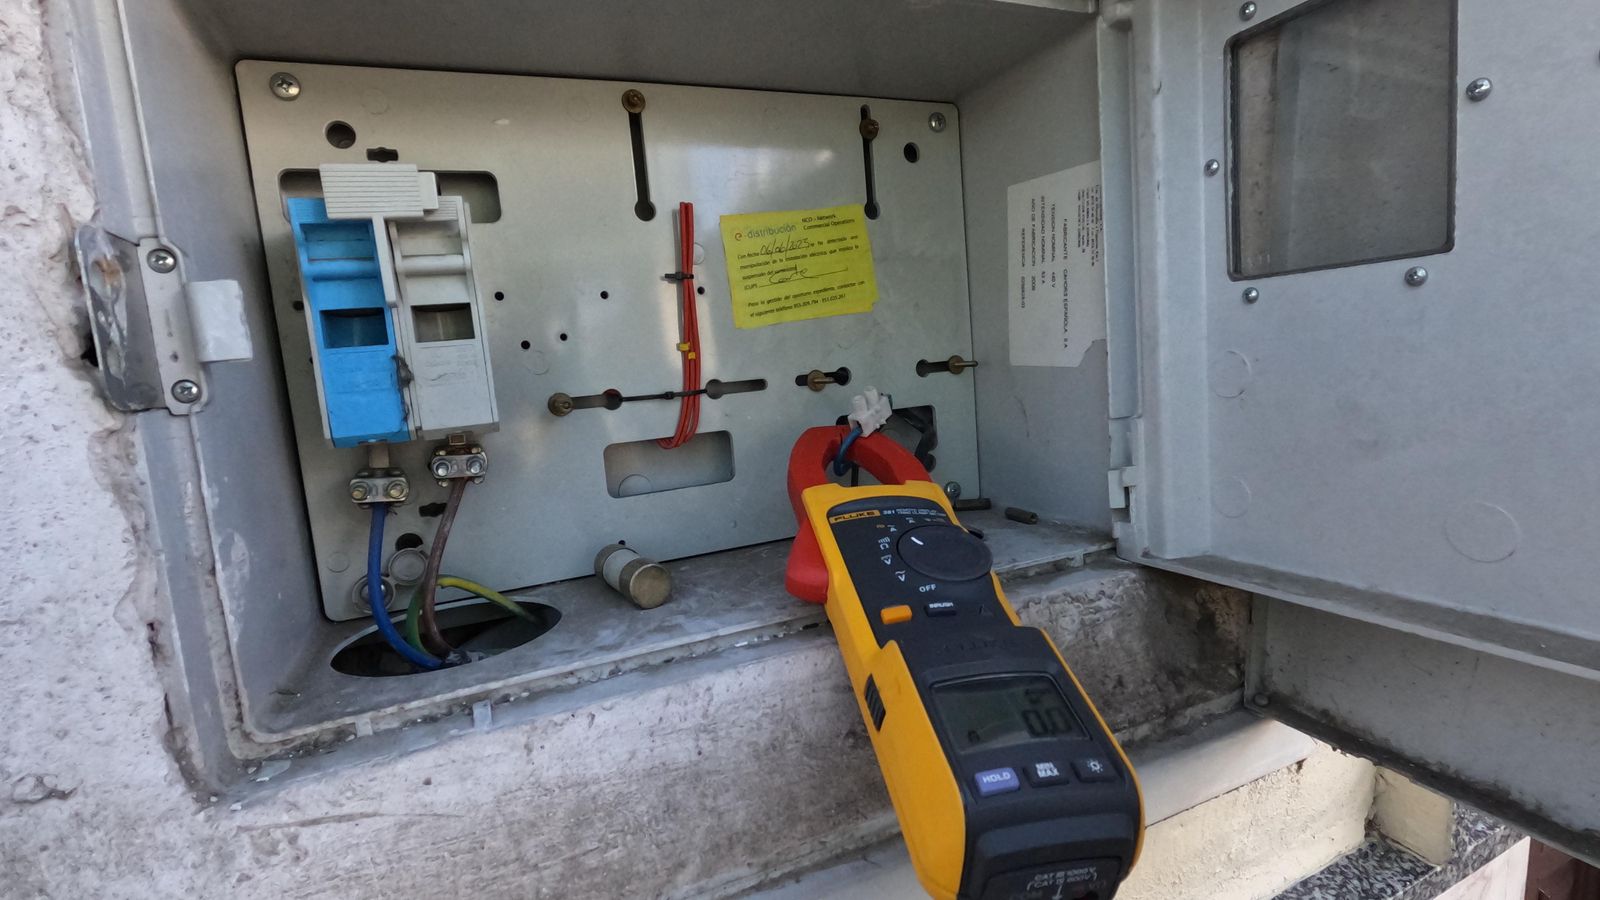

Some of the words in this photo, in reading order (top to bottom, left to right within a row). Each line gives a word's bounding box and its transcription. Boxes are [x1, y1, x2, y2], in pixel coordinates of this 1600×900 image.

[834, 511, 876, 522] FLUKE
[919, 584, 937, 593] OFF
[983, 772, 1011, 784] HOLD
[1037, 768, 1060, 778] MAX
